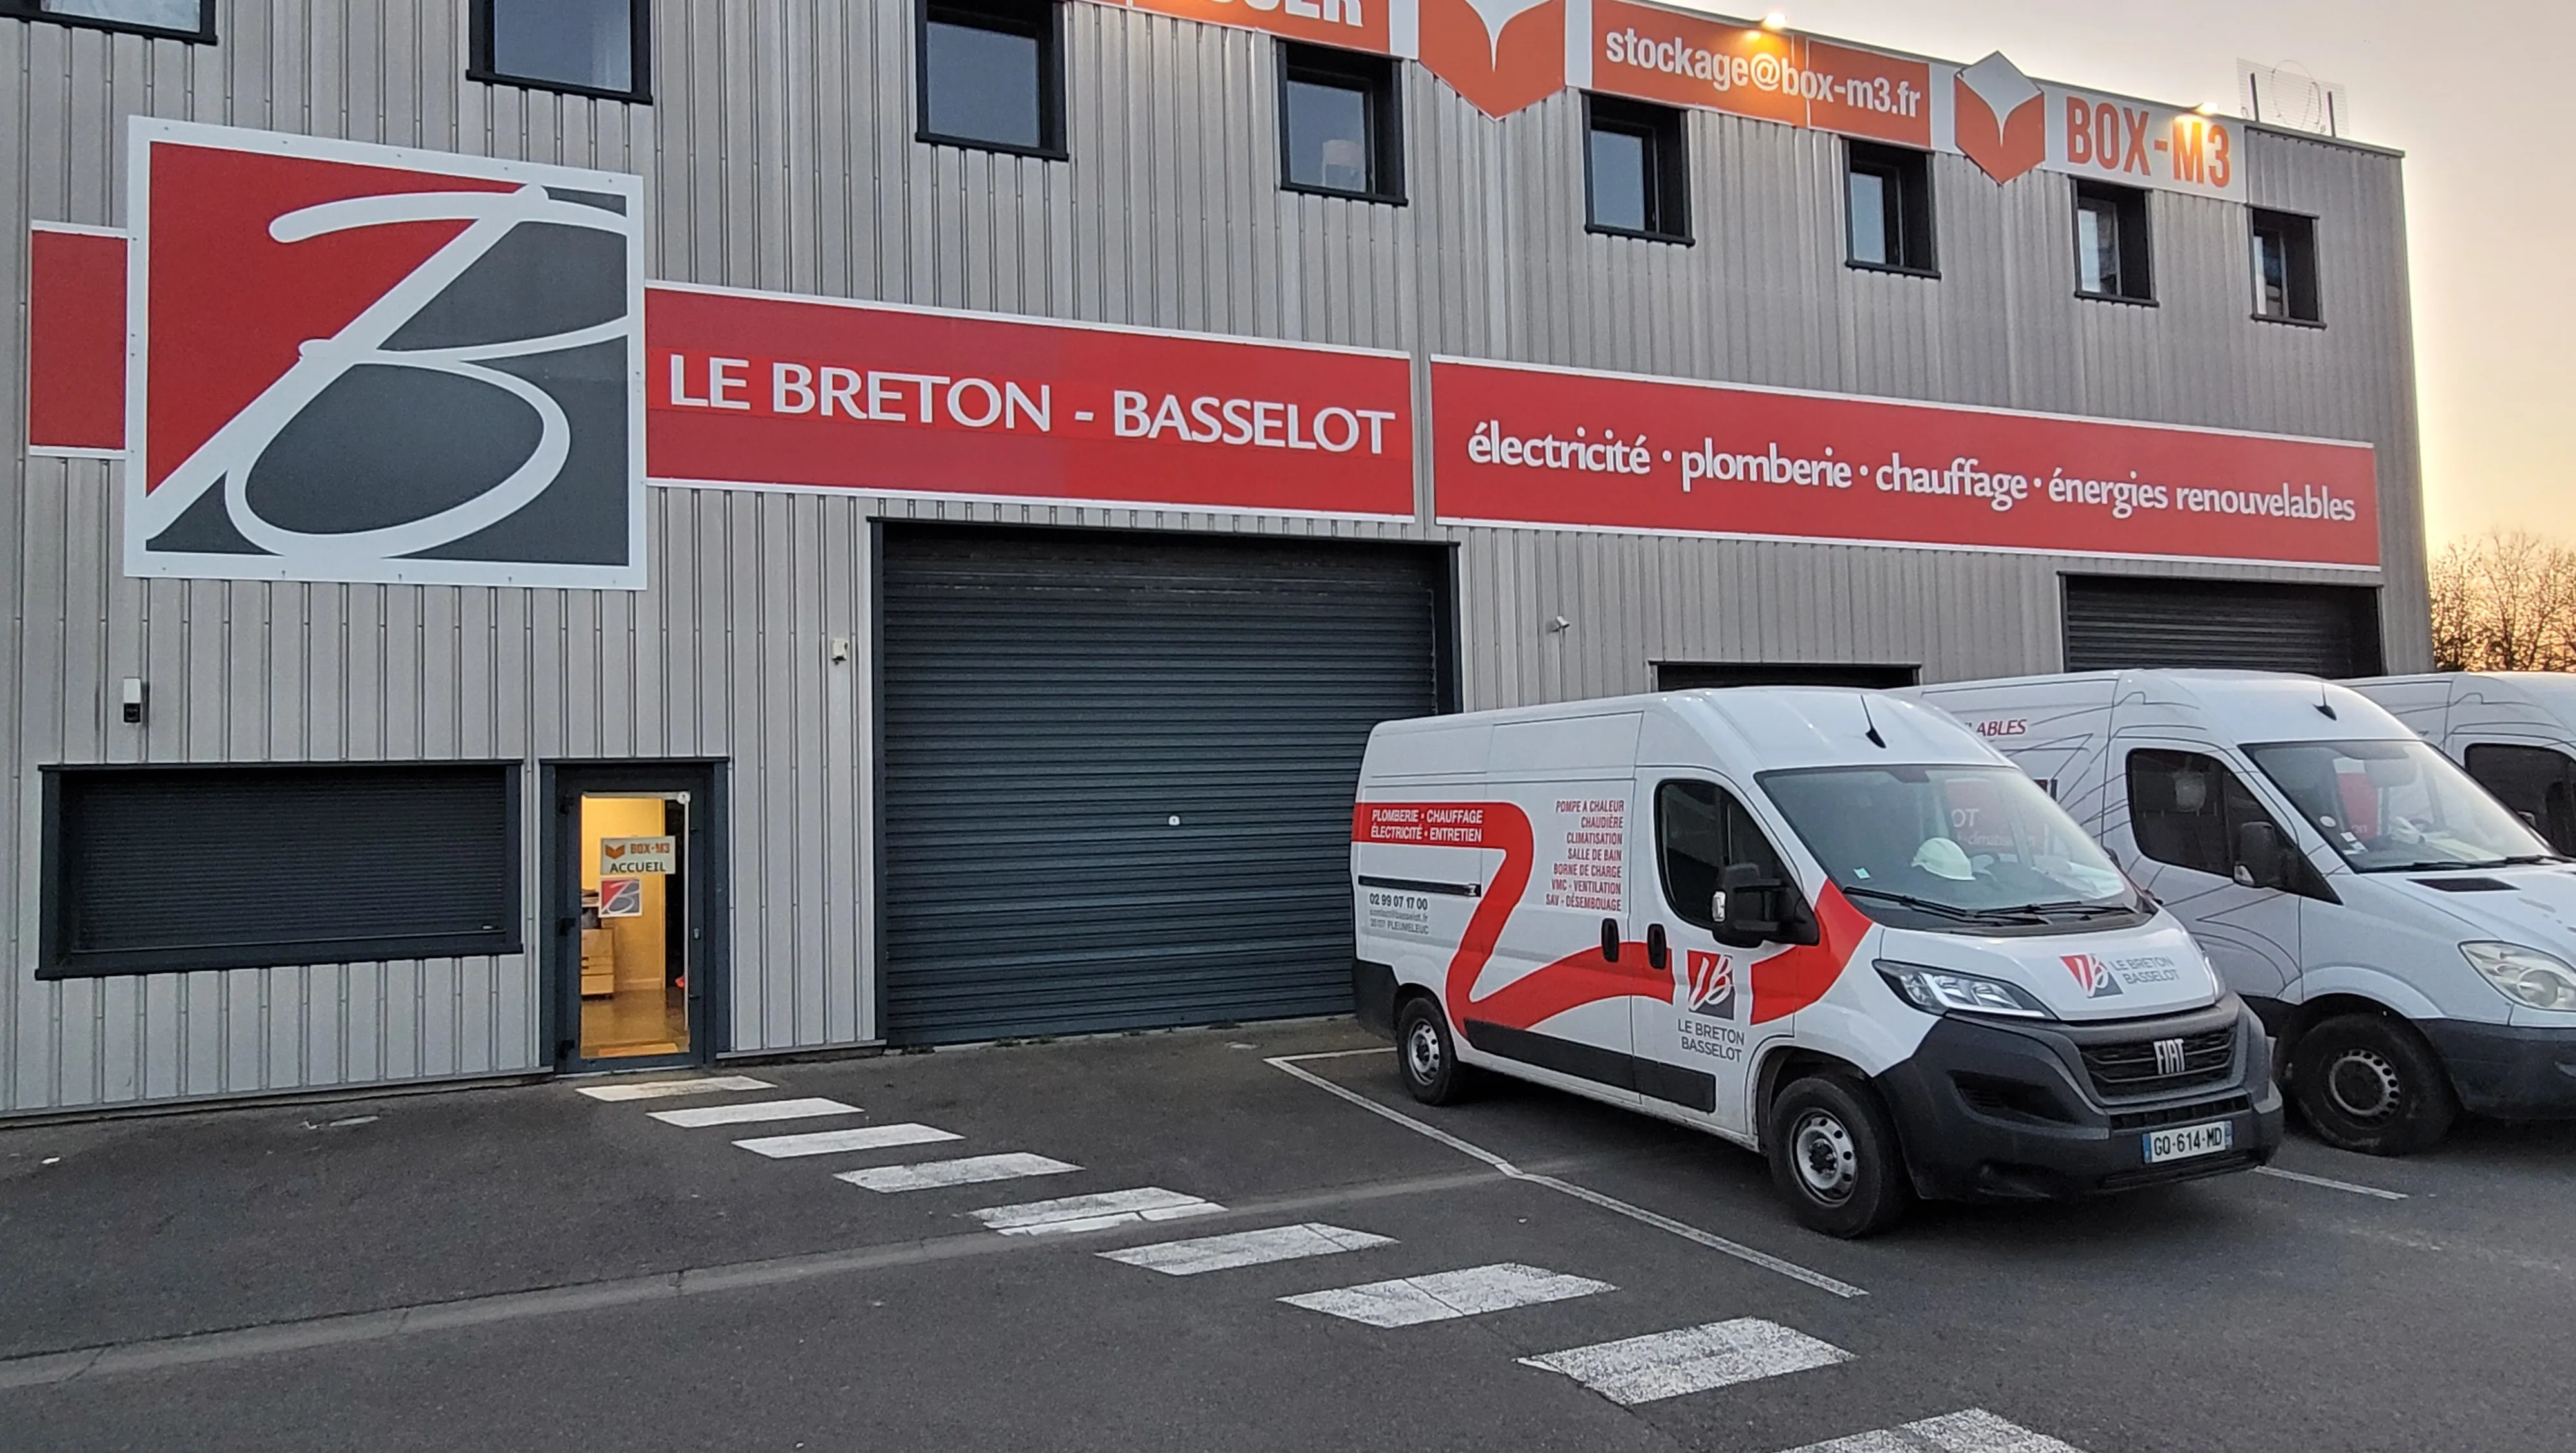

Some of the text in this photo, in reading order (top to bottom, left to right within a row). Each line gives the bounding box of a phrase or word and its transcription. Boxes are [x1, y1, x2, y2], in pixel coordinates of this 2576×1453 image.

[1605, 27, 1922, 119] stockage@box-m3.fr
[2065, 95, 2230, 189] BOX-M3
[670, 354, 751, 411] LE
[772, 362, 1051, 432] BRETON
[1114, 390, 1396, 455] BASSELOT
[1468, 420, 2356, 522] électricité plomberie chauffage énergies renouvelables
[1556, 800, 1581, 813] POMPE
[1589, 800, 1624, 812] CHALEUR
[1372, 809, 1483, 824] PLOMBERIE CHAUFFAGE
[1581, 813, 1624, 828] CHAUDIÈRE
[1371, 823, 1482, 842] ÉLECTRICITÉ ENTRETIEN
[1566, 831, 1622, 845] CLIMATISATION
[630, 842, 670, 854] BOX-M3
[1567, 848, 1622, 861] SALLE DE BAIN
[610, 862, 666, 873] ACCUEIL
[1553, 862, 1622, 878] BORNE DE CHARGE
[1551, 878, 1567, 891] VMC
[1573, 880, 1622, 895] VENTILATION
[1370, 893, 1428, 911] 02 99 07 17 00
[1546, 893, 1559, 906] SAV
[1566, 893, 1622, 911] DÉSEMBOUAGE
[2109, 956, 2174, 971] LE BRETON
[2123, 969, 2180, 984] BASSELOT
[1678, 1018, 1745, 1046] LE BRETON
[1681, 1036, 1742, 1062] BASSELOT
[2154, 1038, 2185, 1074] FIAT
